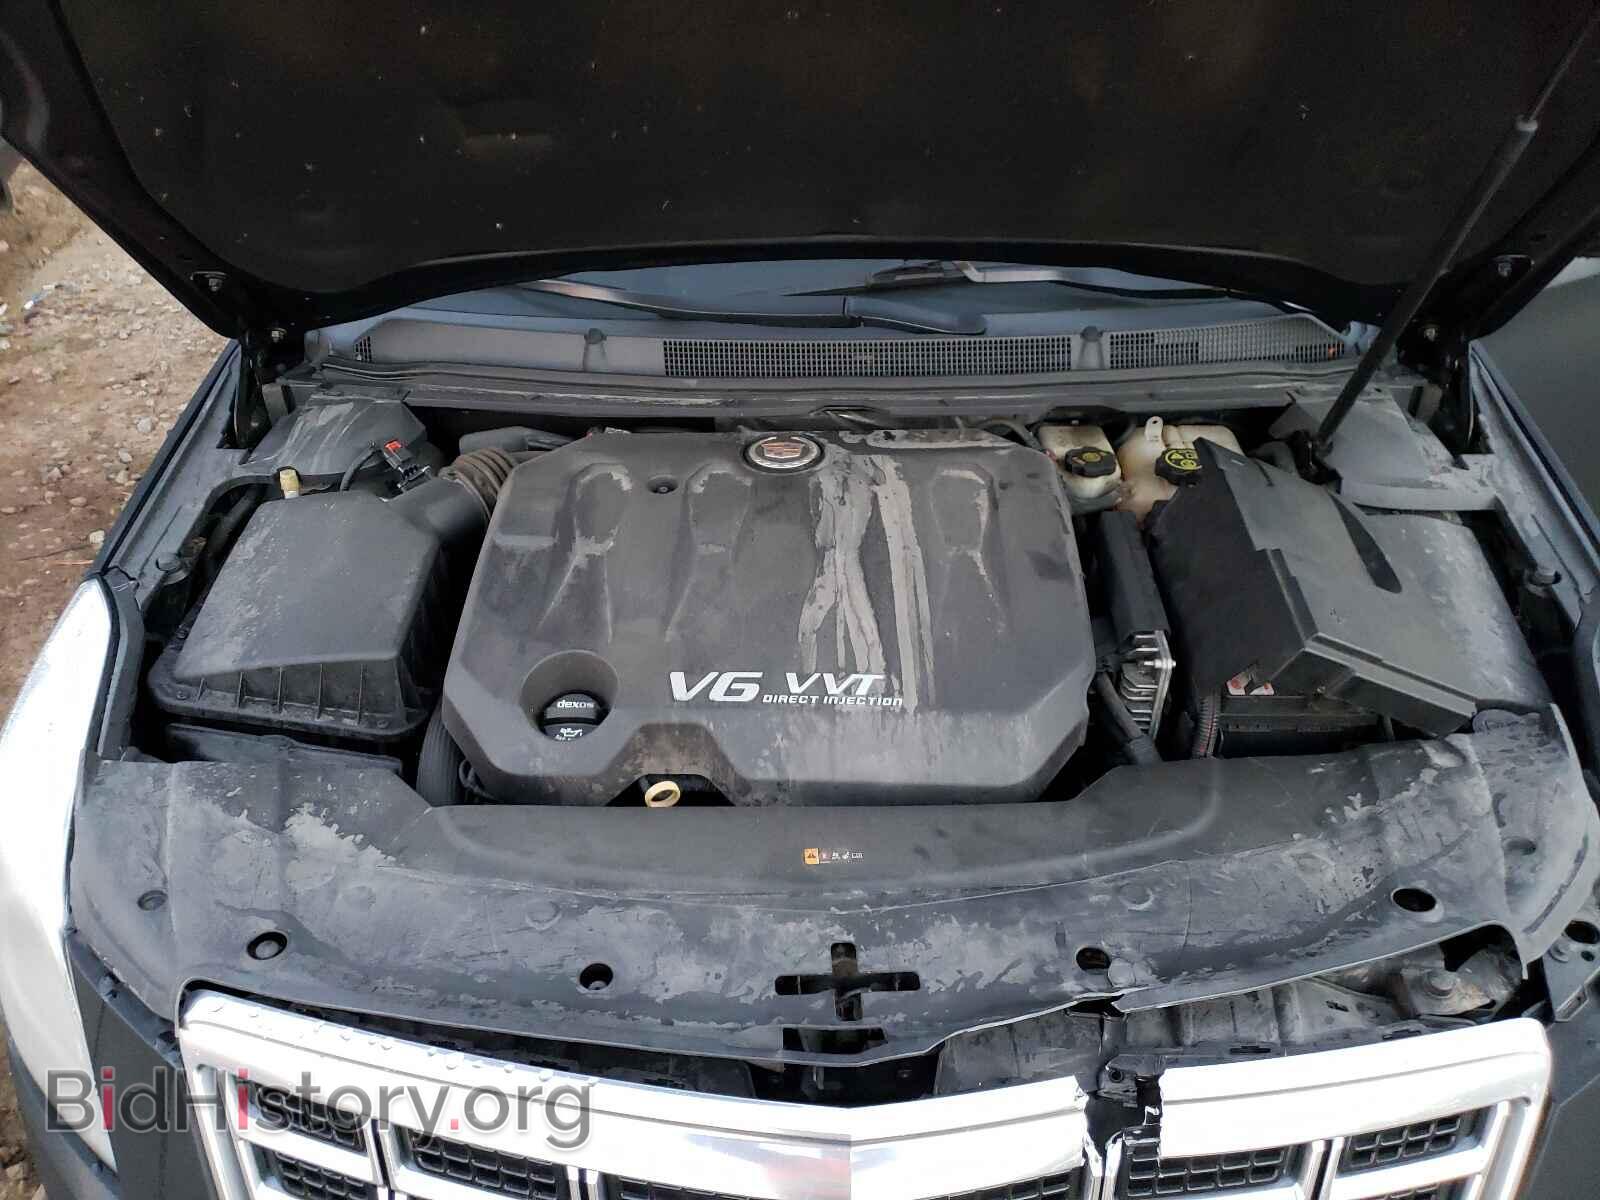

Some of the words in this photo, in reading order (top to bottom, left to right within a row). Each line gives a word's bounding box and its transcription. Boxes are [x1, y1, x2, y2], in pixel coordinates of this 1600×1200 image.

[669, 671, 763, 702] V6
[785, 672, 887, 696] VVT
[556, 699, 595, 709] dexos
[762, 694, 819, 705] DIRECT
[823, 695, 903, 706] INJECTION
